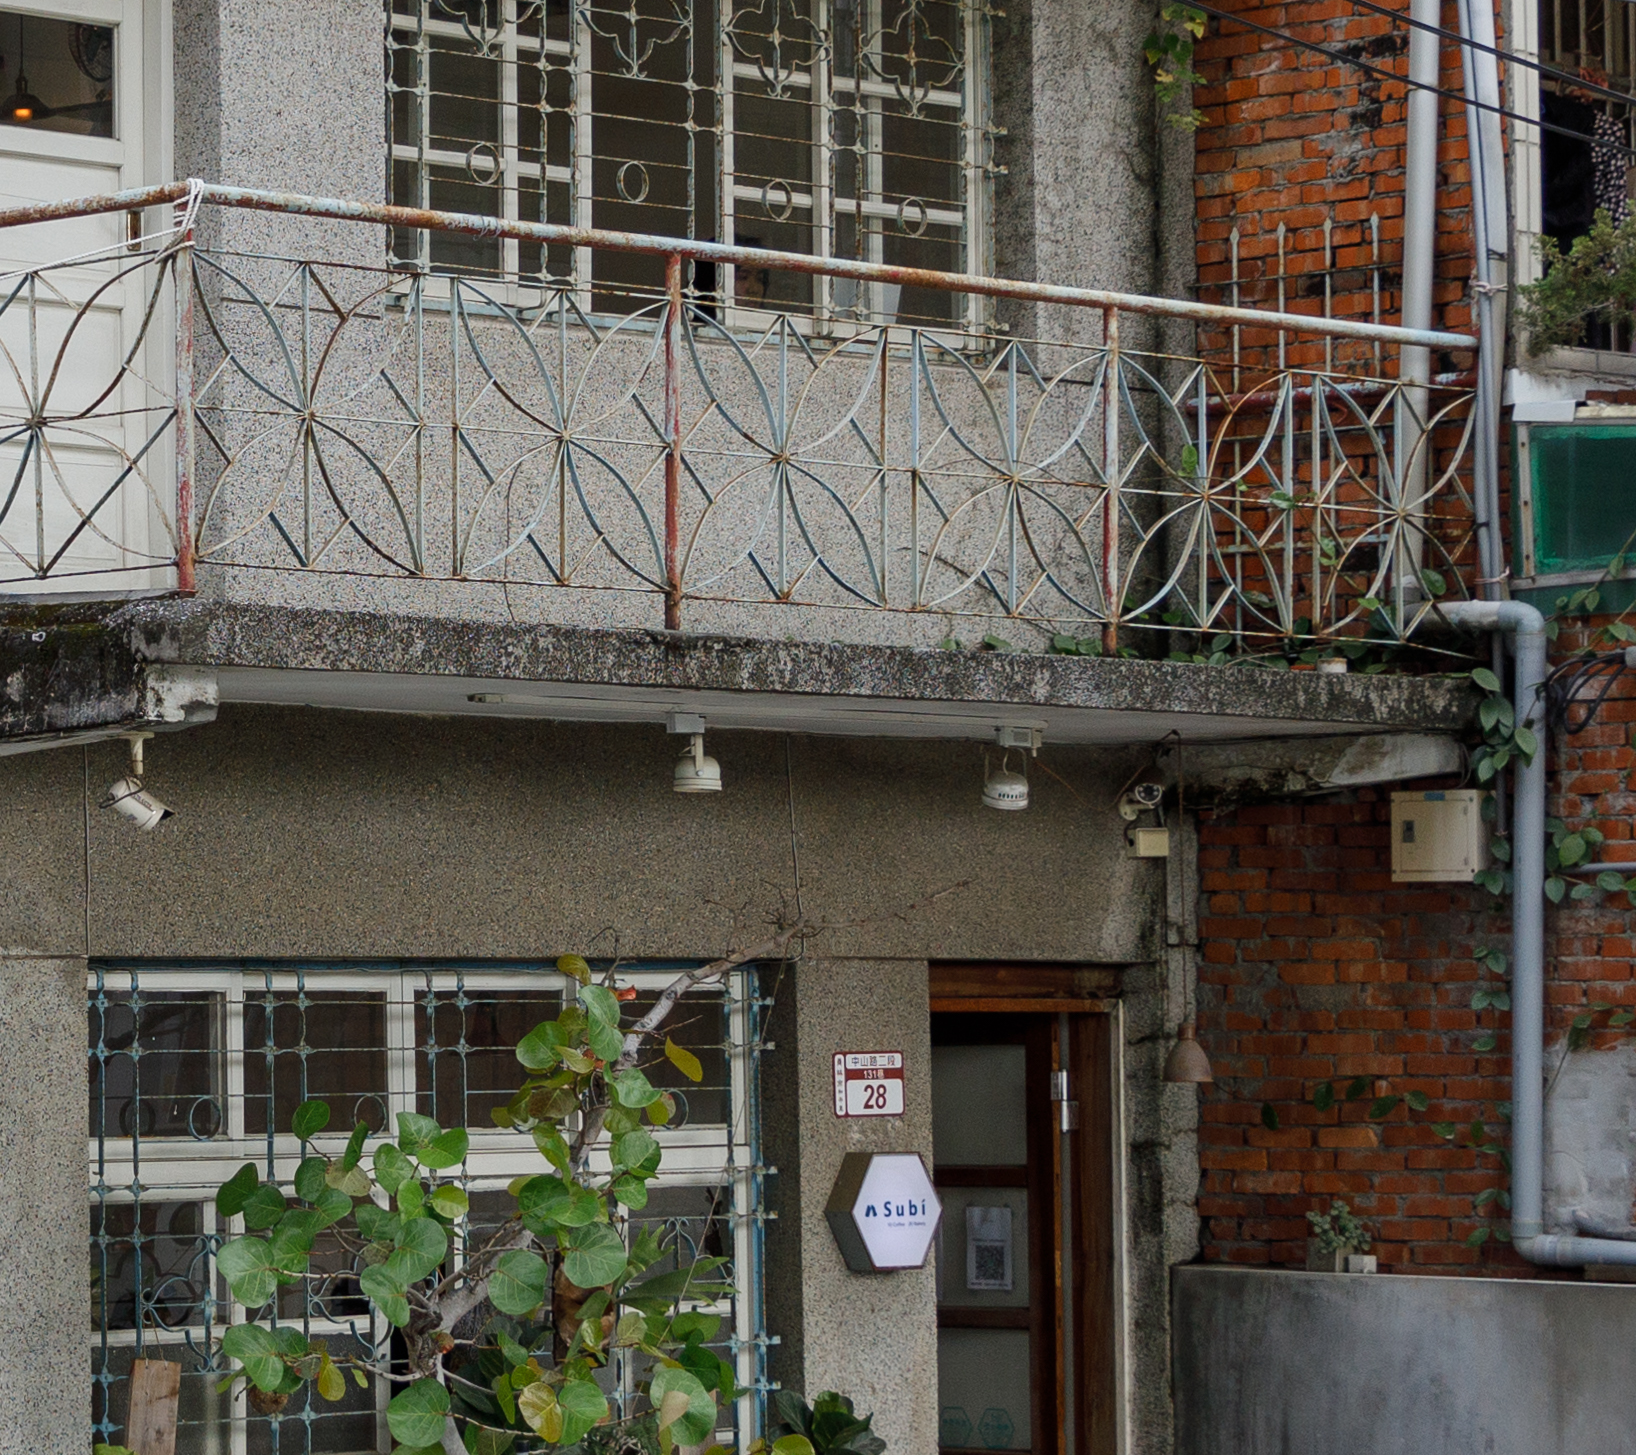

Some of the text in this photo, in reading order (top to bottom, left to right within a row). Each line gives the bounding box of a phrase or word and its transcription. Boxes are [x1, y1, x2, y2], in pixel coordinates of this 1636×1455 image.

[852, 1055, 895, 1067] 中山路二段
[863, 1084, 887, 1109] 28
